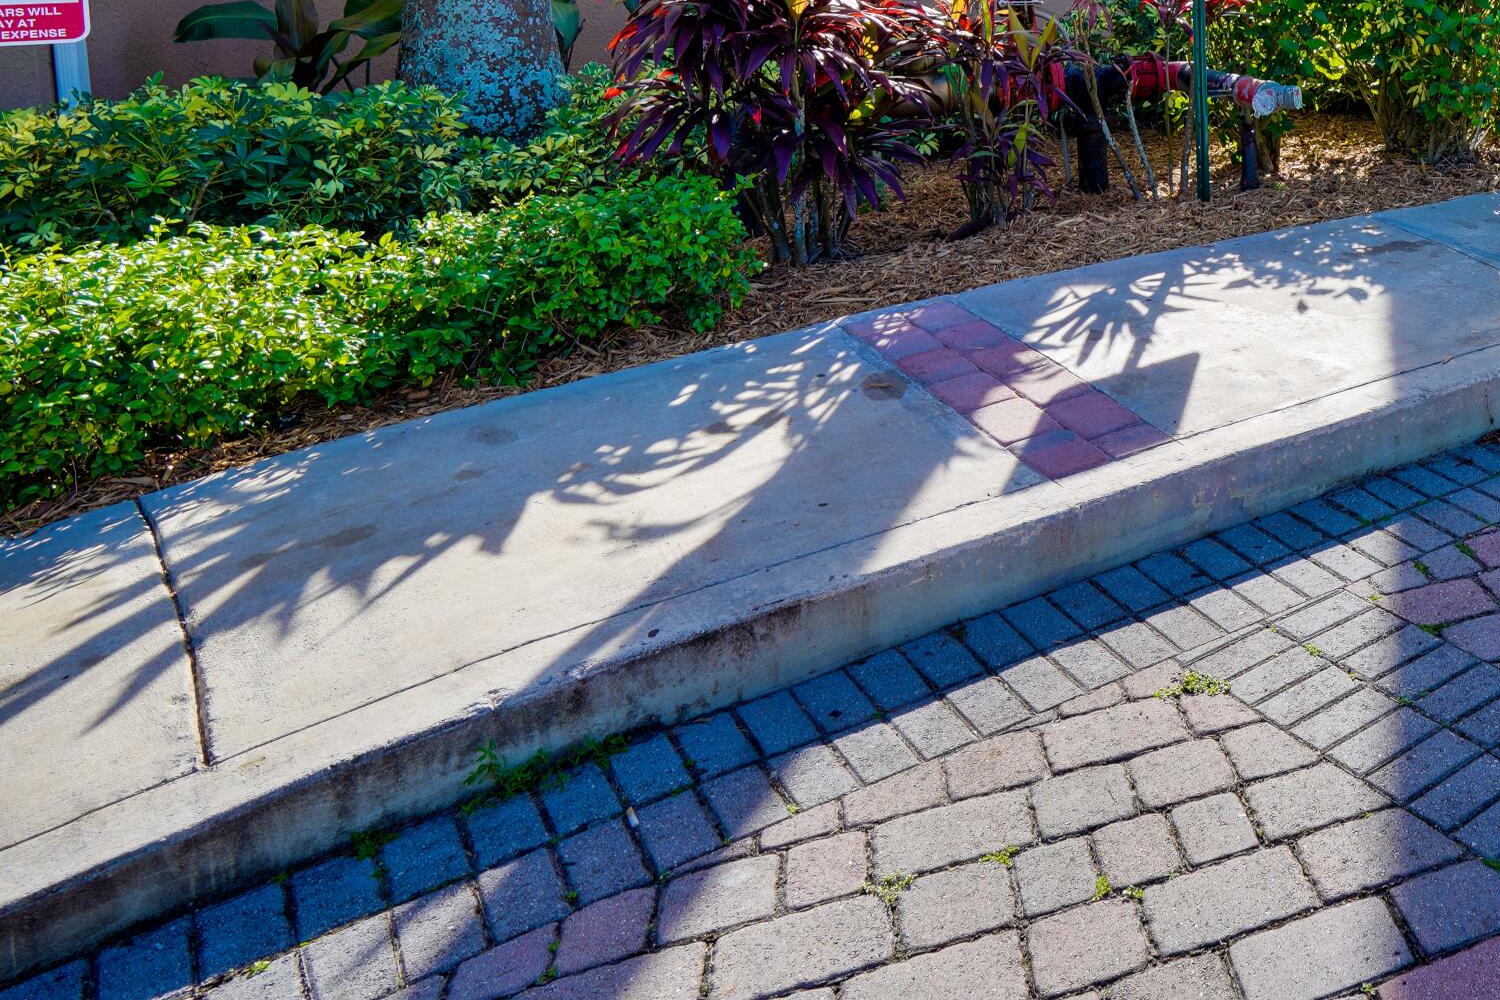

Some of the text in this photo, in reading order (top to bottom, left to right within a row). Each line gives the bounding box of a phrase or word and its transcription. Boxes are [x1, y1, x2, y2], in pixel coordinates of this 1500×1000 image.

[27, 6, 62, 16] WILL
[17, 18, 36, 28] AT
[1, 28, 67, 40] EXPENSE
